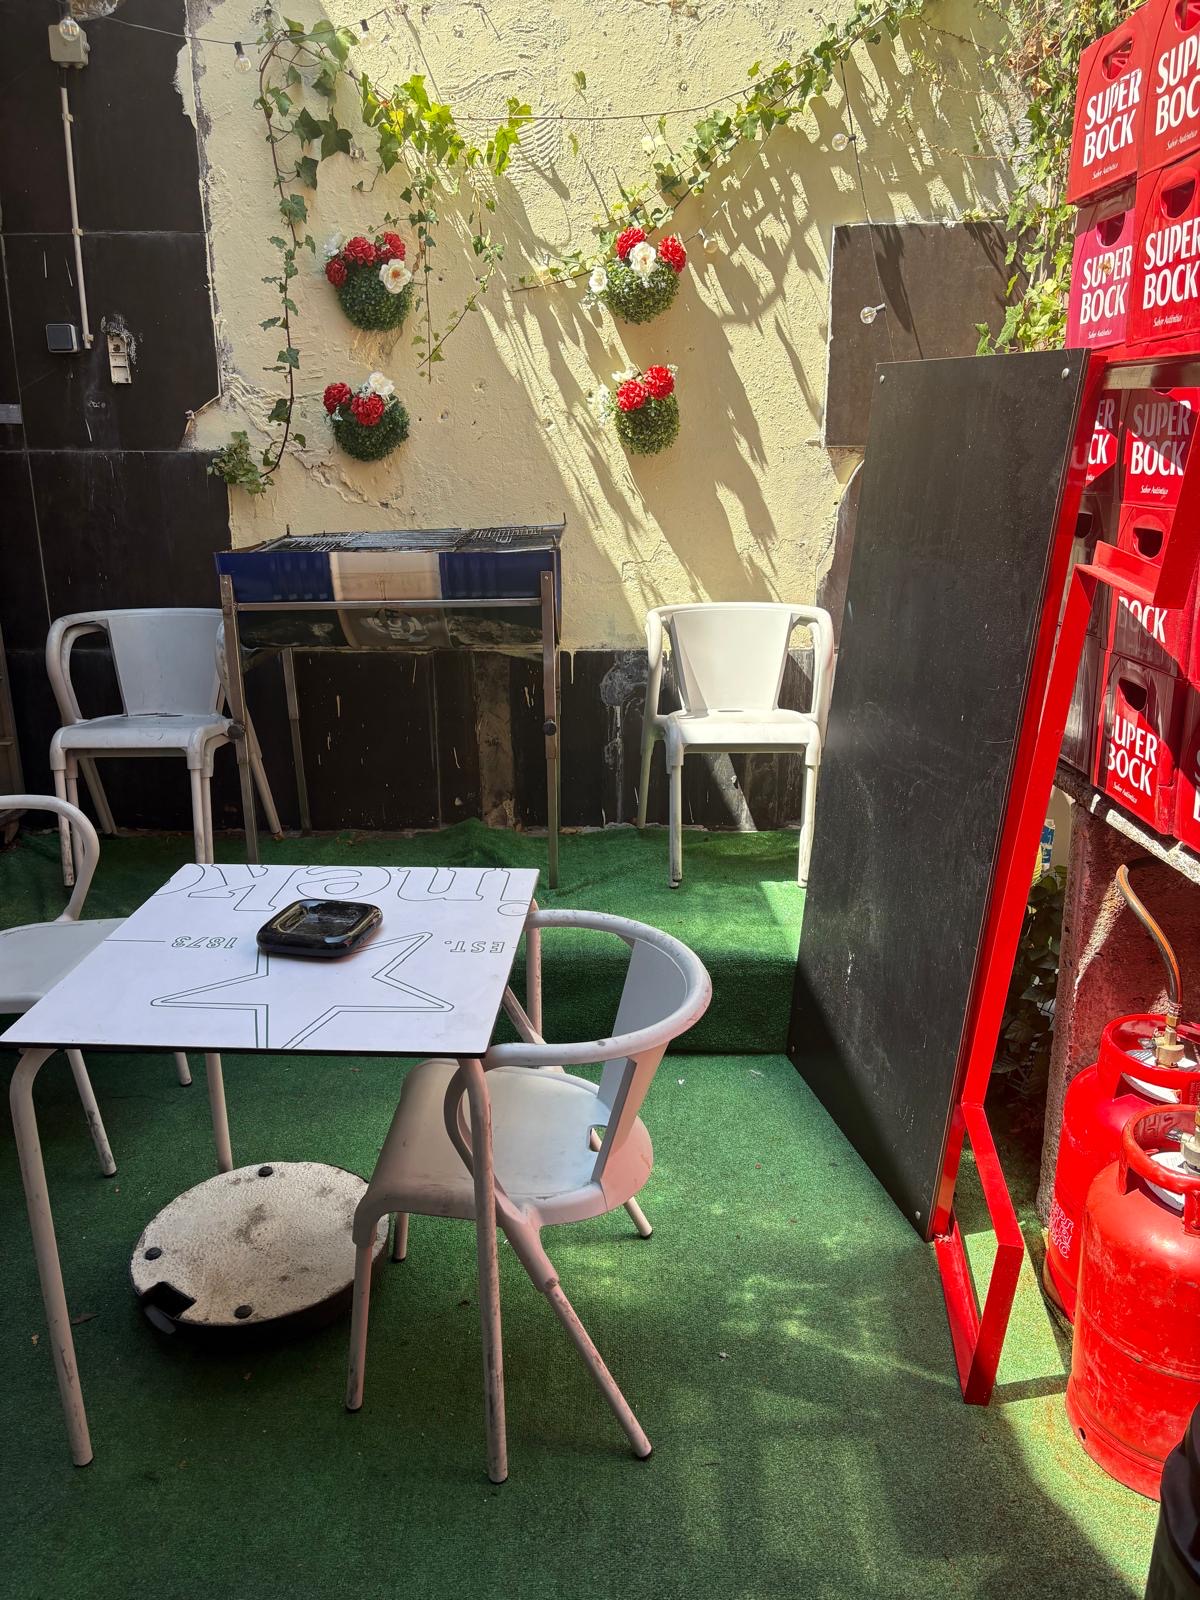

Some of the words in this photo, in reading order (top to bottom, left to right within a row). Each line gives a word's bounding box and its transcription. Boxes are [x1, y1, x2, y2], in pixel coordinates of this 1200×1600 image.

[1156, 34, 1200, 93] SUP
[1085, 68, 1142, 130] SUPER
[1083, 109, 1136, 167] BOCK
[1081, 245, 1133, 290] SUPER
[1142, 261, 1200, 310] BOCK
[1080, 282, 1129, 325] BOCK
[1132, 400, 1192, 438] SUPER
[1130, 440, 1187, 476] BOCK
[1111, 715, 1157, 766] UPER
[172, 935, 238, 950] 1873
[443, 940, 505, 954] EST.
